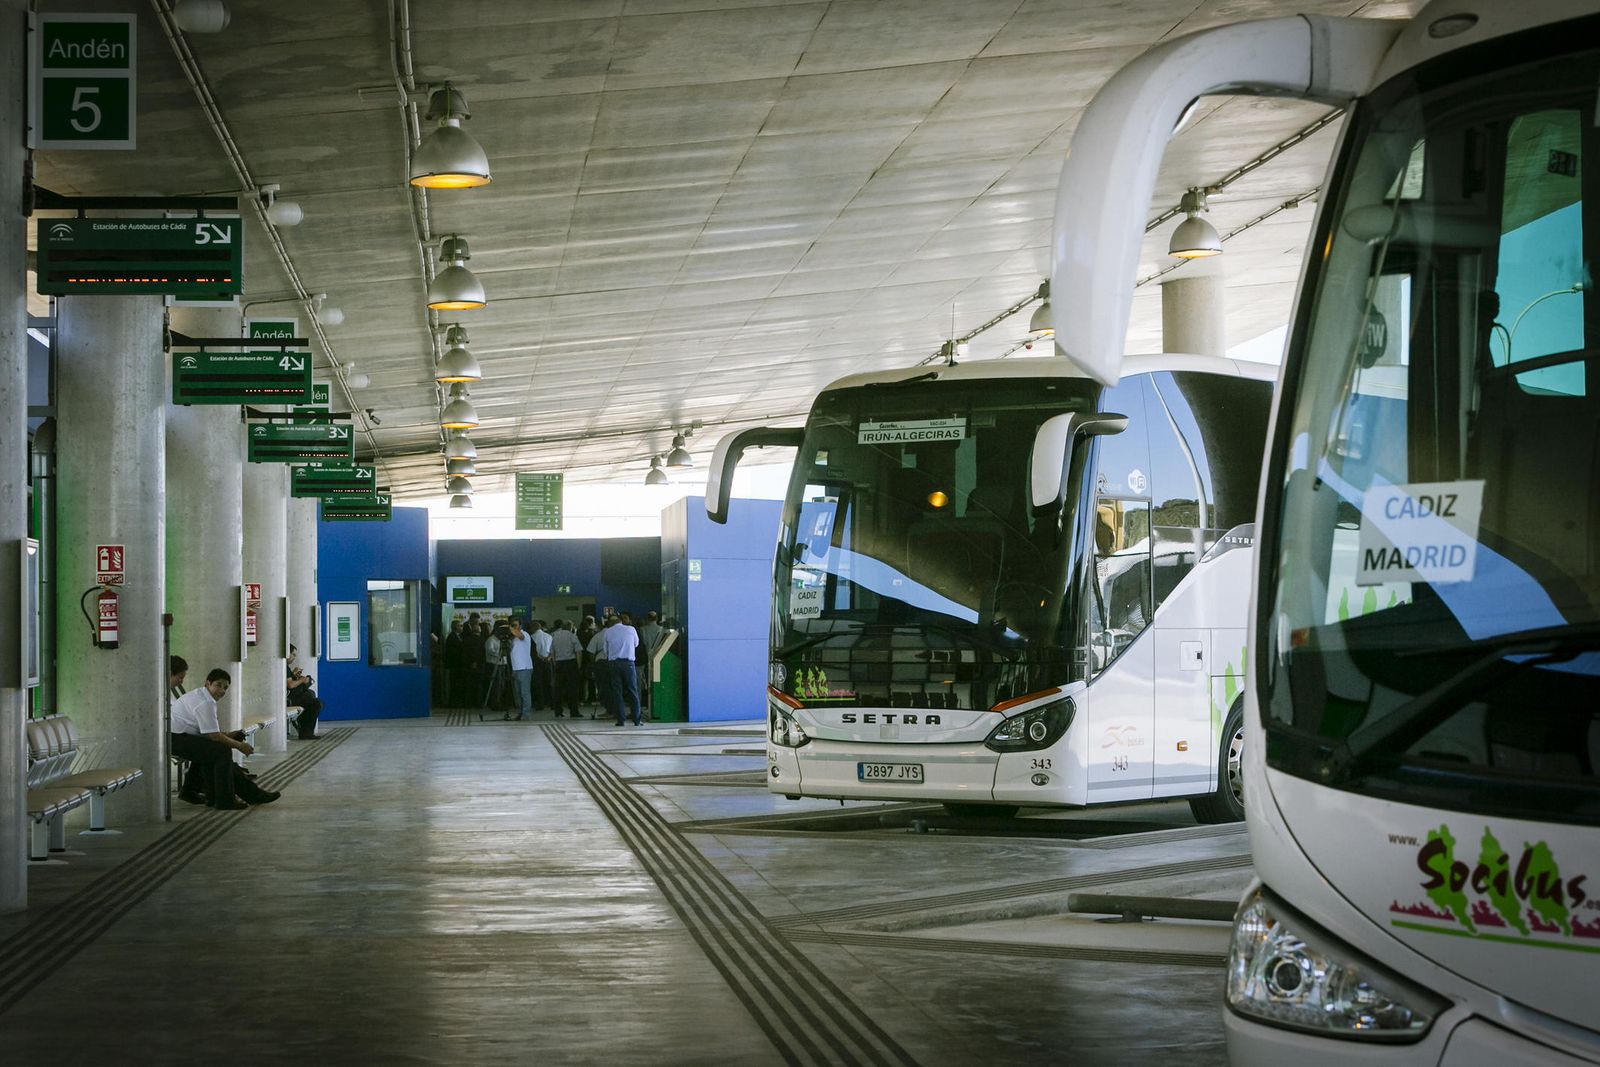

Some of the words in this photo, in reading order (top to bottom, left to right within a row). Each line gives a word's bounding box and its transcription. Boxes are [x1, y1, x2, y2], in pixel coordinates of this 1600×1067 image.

[48, 38, 125, 60] Andén
[70, 87, 102, 133] 5
[169, 222, 187, 230] Cádiz
[195, 223, 211, 245] 5
[279, 356, 291, 371] 4
[328, 426, 338, 439] 3
[863, 429, 960, 442] IRÚN-ALGECIRAS
[355, 468, 364, 478] 2
[376, 496, 381, 504] 1
[1384, 494, 1459, 520] CADIZ
[1363, 545, 1467, 572] MADRID
[797, 591, 818, 600] CADIZ
[793, 606, 819, 615] MADRID
[842, 713, 941, 725] SETRA
[1030, 758, 1052, 770] 343
[1112, 755, 1129, 772] 343
[866, 765, 894, 778] 2897
[898, 766, 919, 778] JYS
